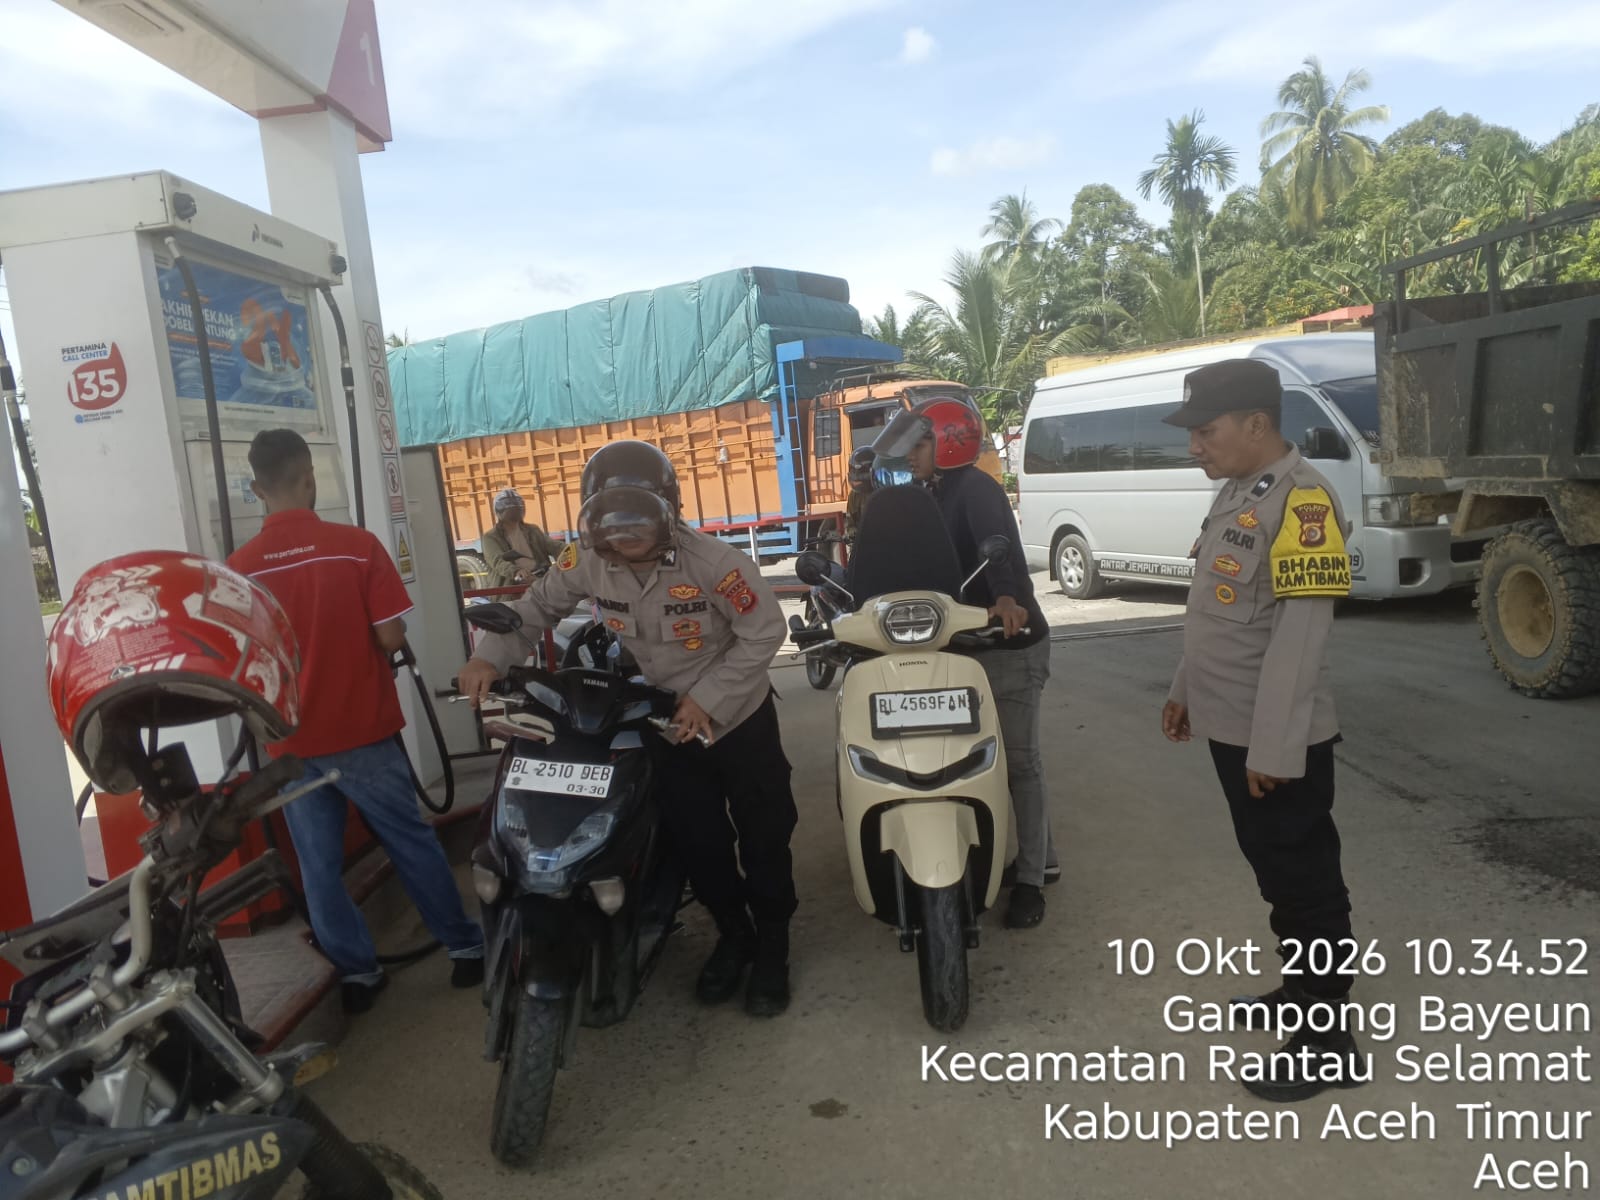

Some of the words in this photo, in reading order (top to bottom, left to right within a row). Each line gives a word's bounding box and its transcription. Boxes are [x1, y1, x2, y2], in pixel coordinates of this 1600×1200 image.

[202, 308, 234, 328] EKAN
[165, 315, 194, 332] OBEL
[203, 323, 237, 340] NTUNG
[61, 342, 107, 354] PERTAMINA
[80, 350, 109, 359] CENTER
[69, 368, 121, 402] 135
[1222, 528, 1256, 550] POLRI
[1100, 559, 1126, 571] ANTAR
[1127, 562, 1159, 574] JEMPUT
[1160, 564, 1190, 577] ANTAR
[1279, 557, 1346, 574] BHABIN
[1275, 571, 1350, 589] KAMTIBMAS
[664, 600, 708, 616] POLRI
[583, 678, 609, 688] YAMAHA
[879, 699, 897, 714] BL
[511, 759, 528, 774] BL
[535, 762, 574, 779] 2510
[566, 783, 605, 795] 03-30
